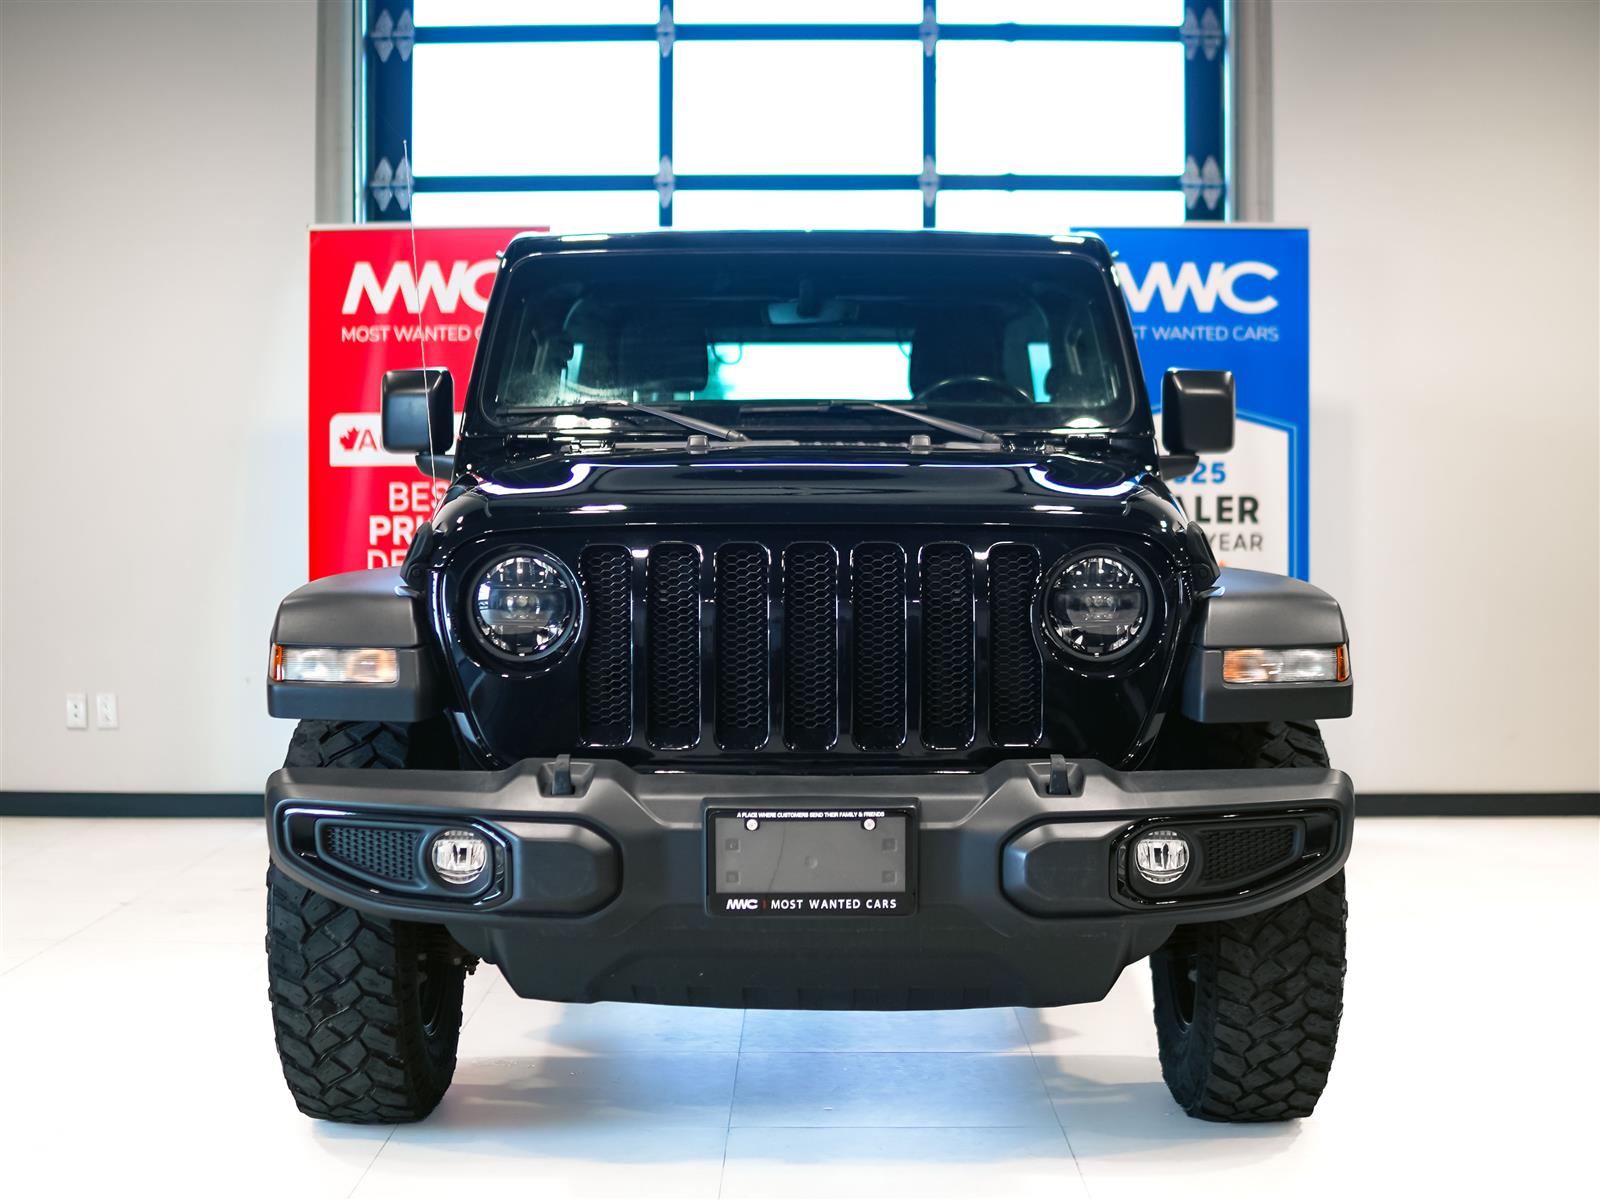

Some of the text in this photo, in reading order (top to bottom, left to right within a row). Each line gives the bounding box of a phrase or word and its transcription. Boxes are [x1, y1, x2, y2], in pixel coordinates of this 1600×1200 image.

[341, 326, 390, 342] MOST
[394, 325, 471, 342] WANTED
[1152, 326, 1229, 341] WANTED
[1233, 326, 1280, 342] CARS
[1174, 462, 1226, 484] 25
[389, 481, 449, 512] BES
[1176, 495, 1259, 524] LER
[726, 899, 897, 910] MWC MOST WANTED CARS
